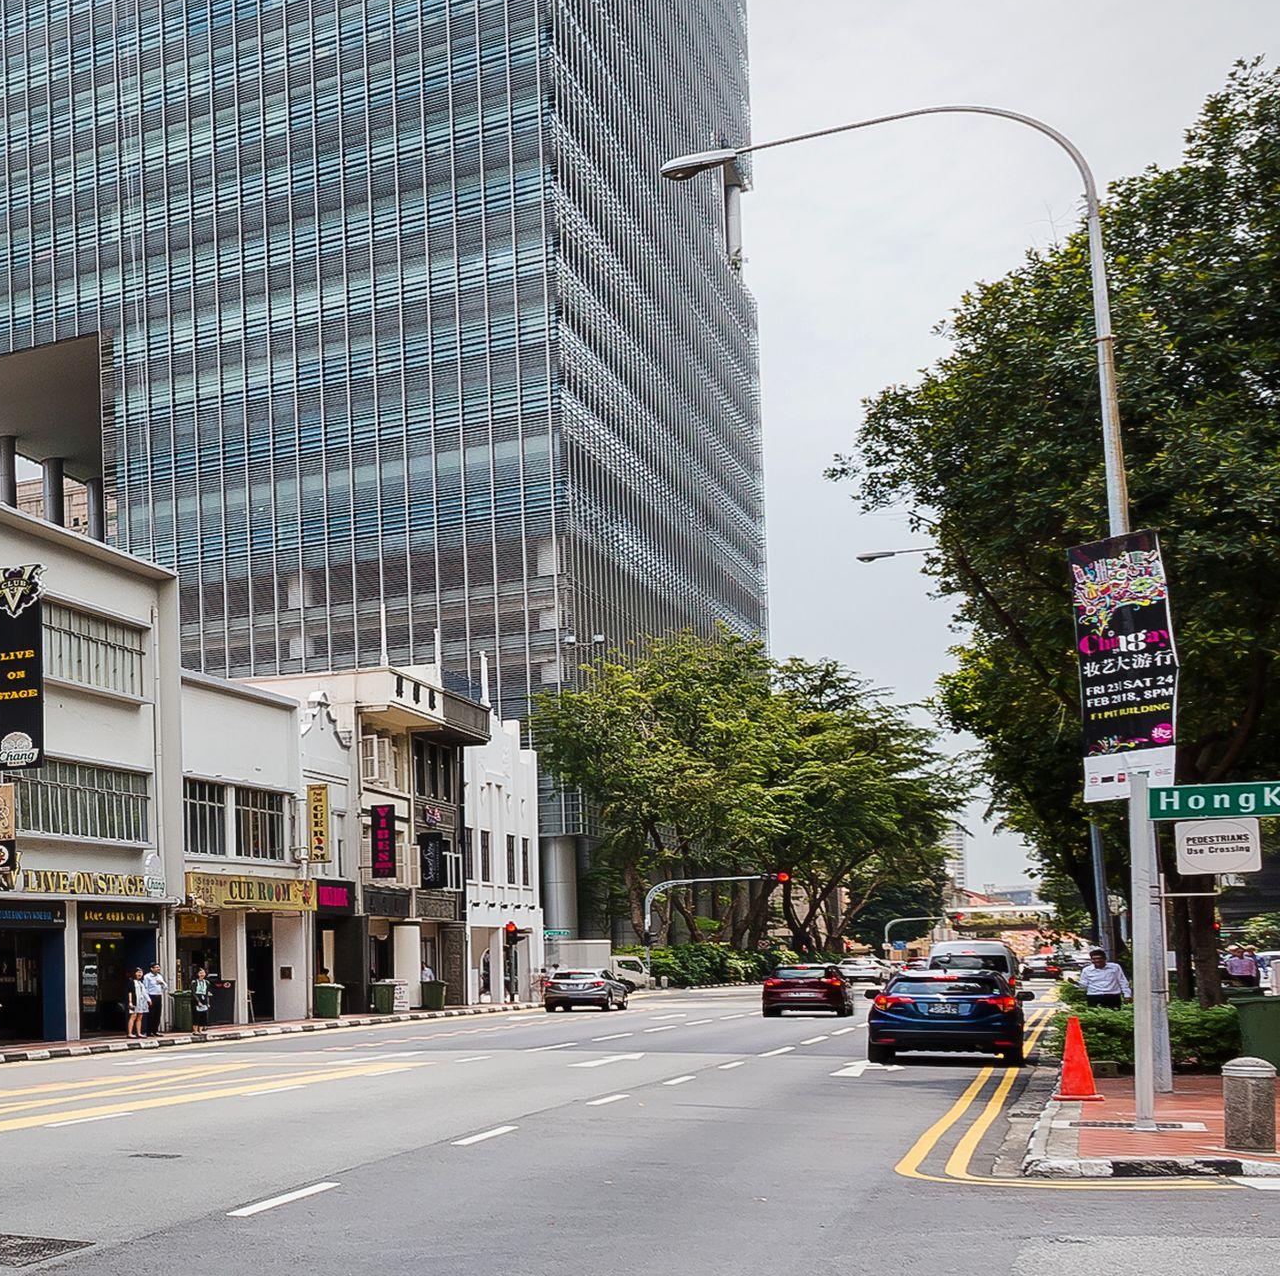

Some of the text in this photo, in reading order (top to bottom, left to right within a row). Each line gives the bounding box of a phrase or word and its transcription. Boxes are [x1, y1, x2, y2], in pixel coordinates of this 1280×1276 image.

[2, 579, 27, 588] CLUB
[0, 649, 35, 661] LIVE
[1083, 649, 1174, 677] 妆艺大游行
[7, 670, 26, 680] ON
[1086, 685, 1105, 696] FRI
[1124, 677, 1154, 689] SAT
[1156, 675, 1174, 685] 24
[1086, 697, 1109, 707] FEB
[1143, 687, 1174, 699] 8PM
[1185, 834, 1250, 844] PEDESTRIANS
[1186, 845, 1251, 855] Use Crossing
[25, 869, 70, 893] LIVE
[73, 871, 95, 894] ON
[96, 872, 146, 897] STAGE
[229, 881, 254, 900] CUE
